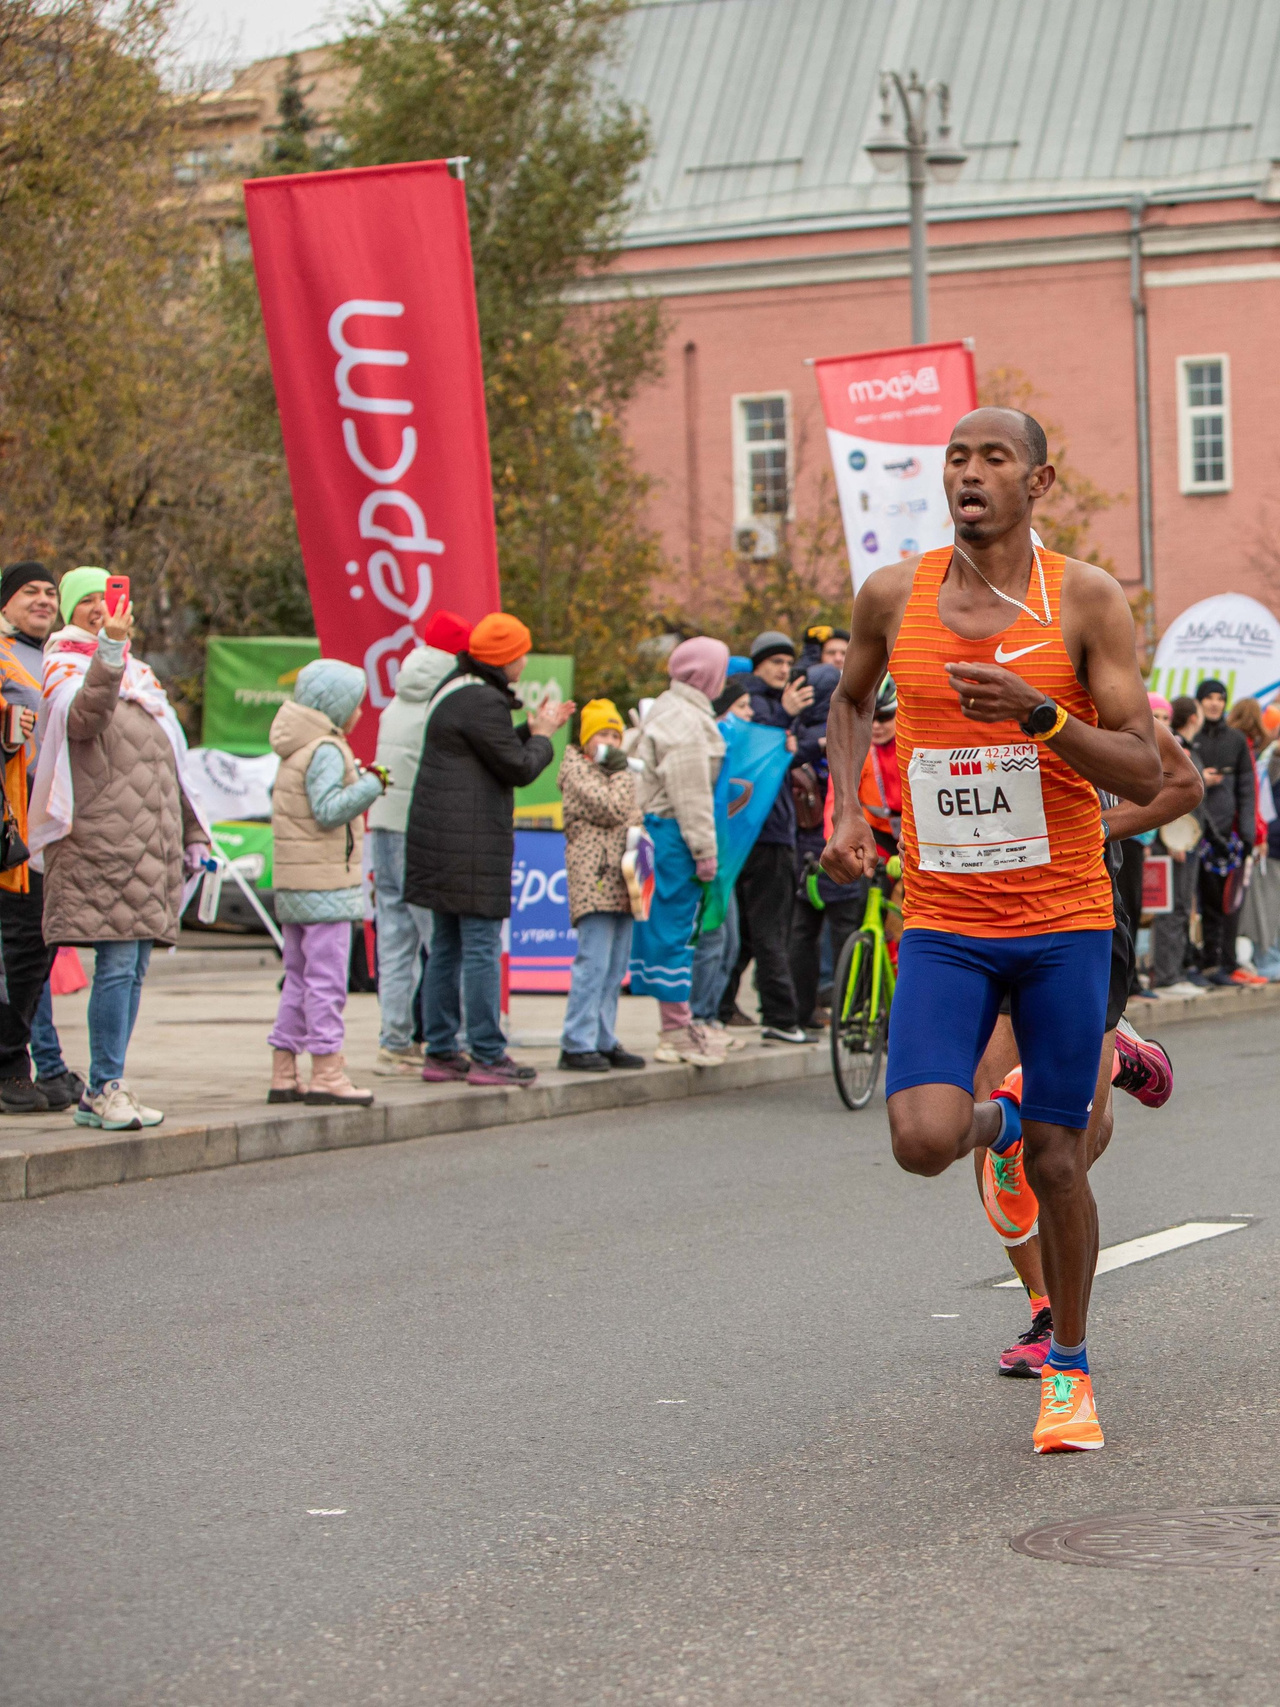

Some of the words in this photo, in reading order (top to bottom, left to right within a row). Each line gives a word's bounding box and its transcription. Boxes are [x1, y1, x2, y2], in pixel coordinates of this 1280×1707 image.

[984, 747, 1011, 759] 42,2
[937, 786, 1012, 816] GELA
[973, 828, 980, 838] 4
